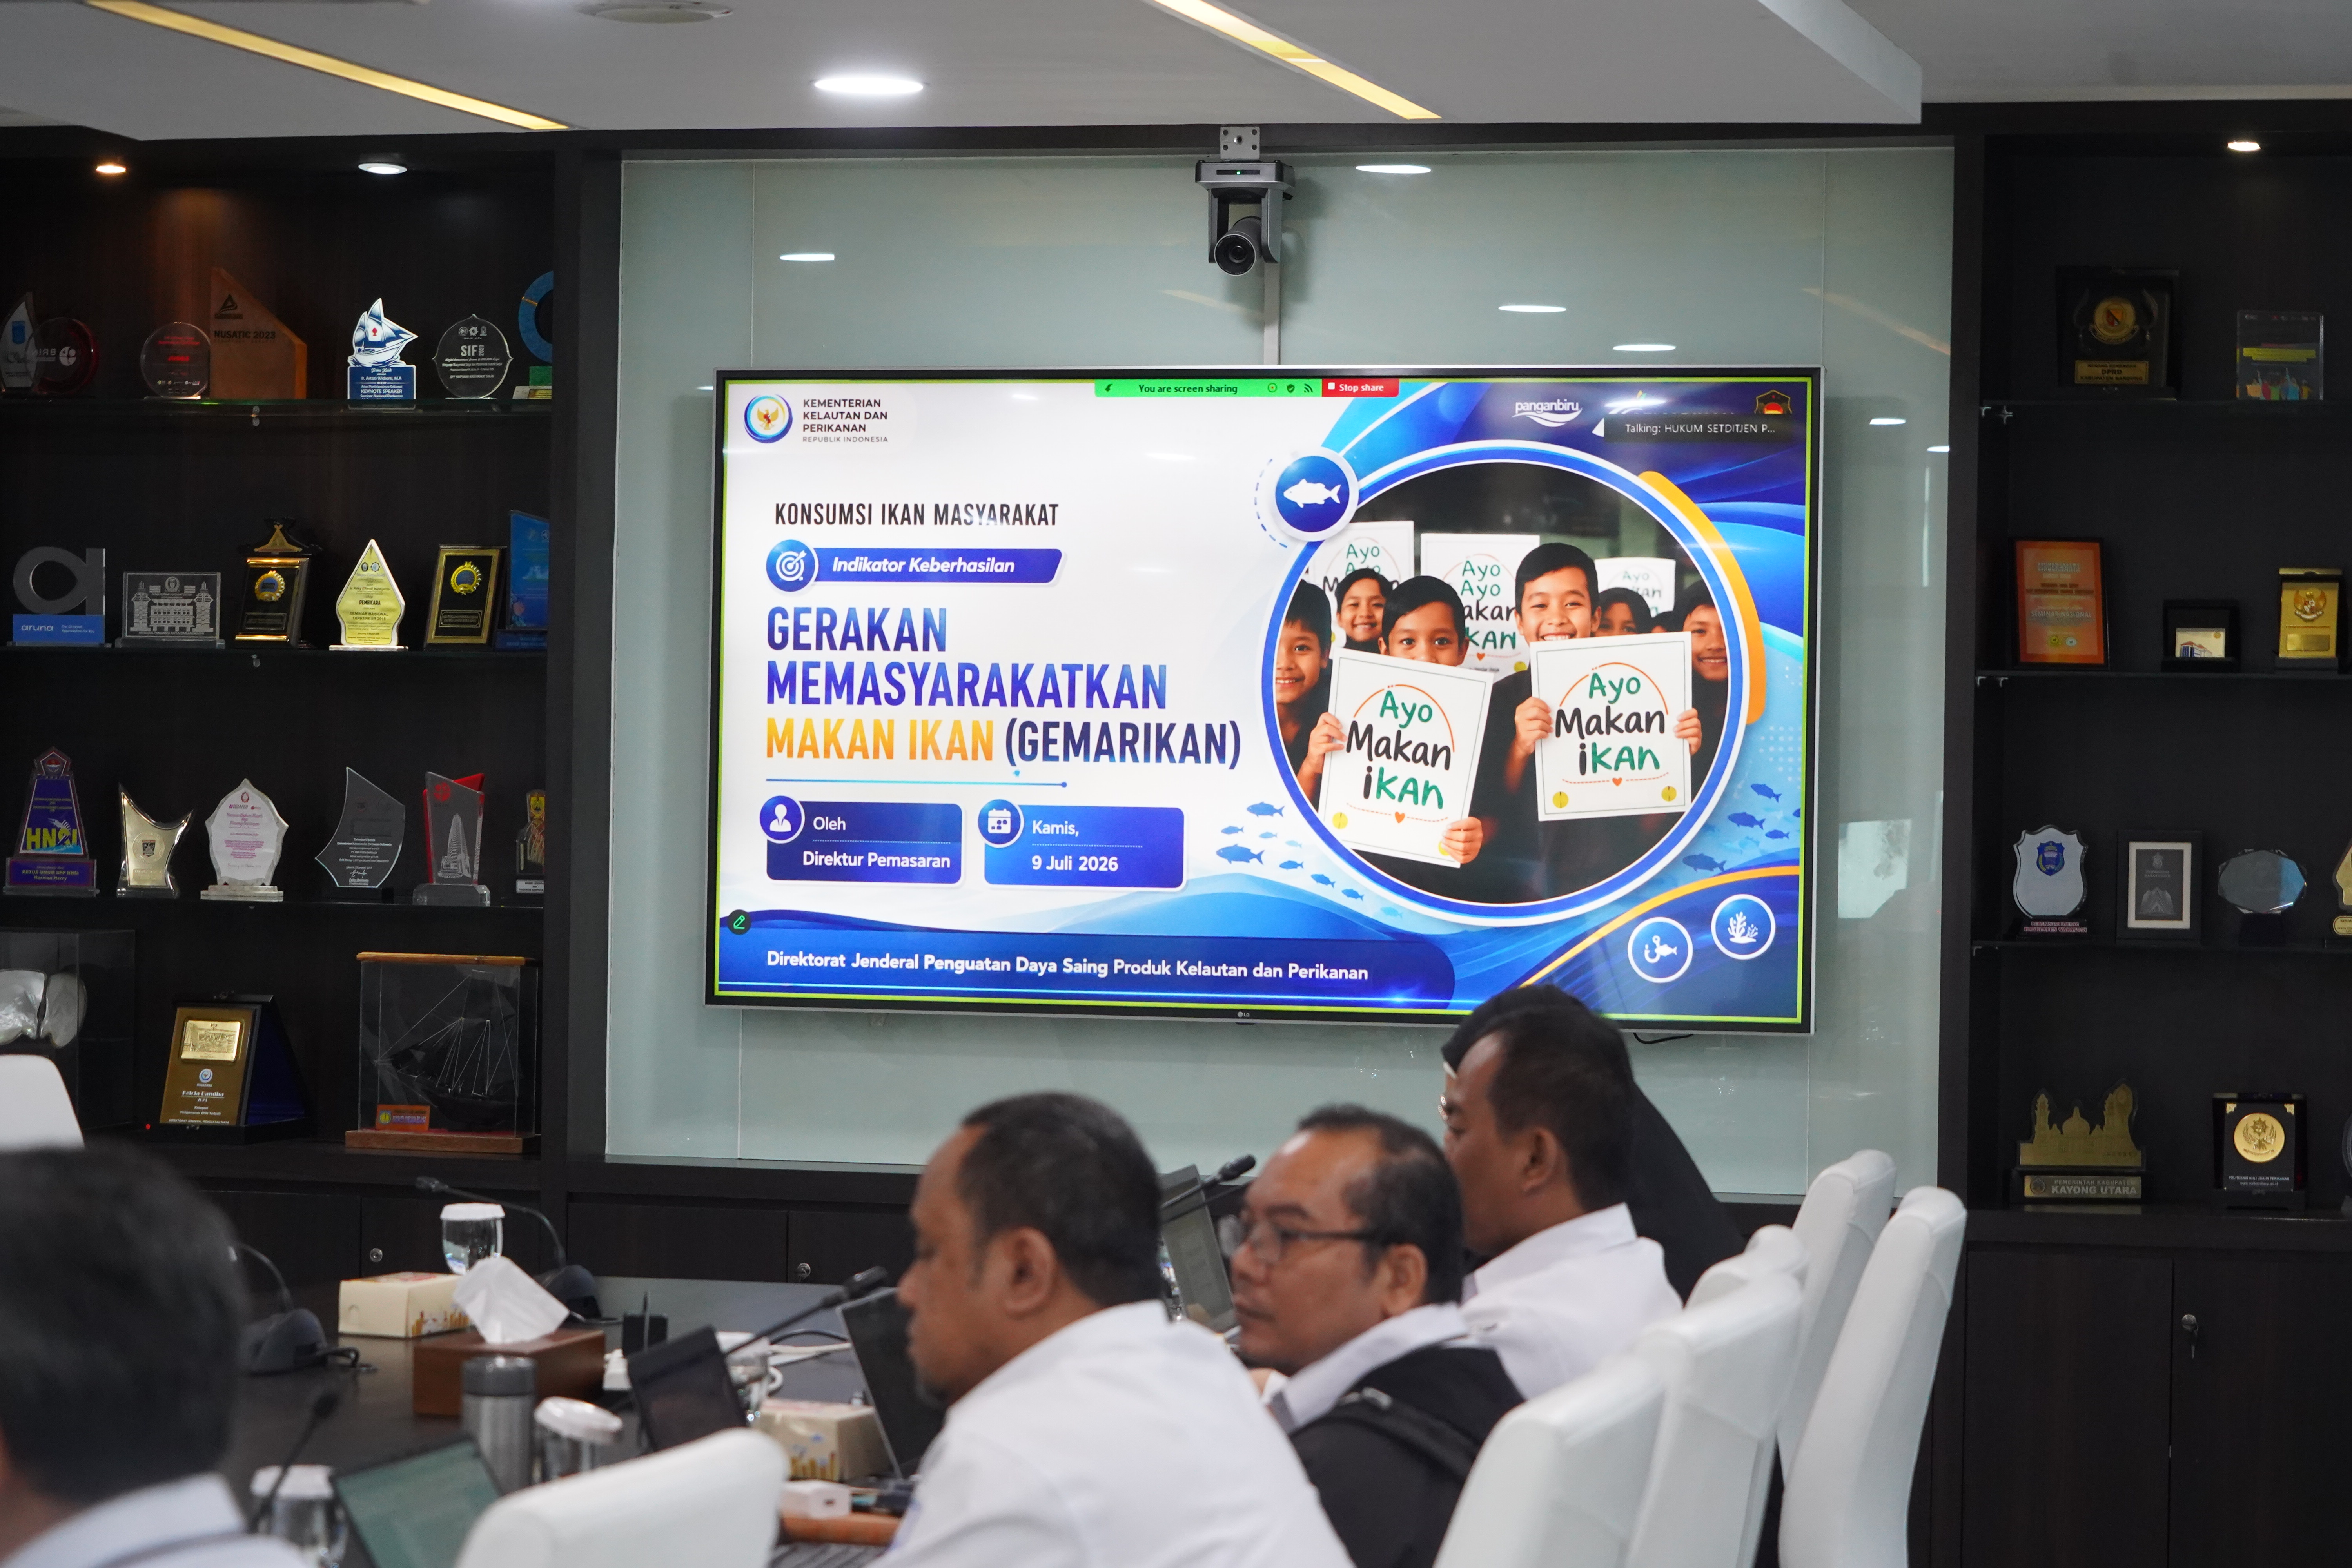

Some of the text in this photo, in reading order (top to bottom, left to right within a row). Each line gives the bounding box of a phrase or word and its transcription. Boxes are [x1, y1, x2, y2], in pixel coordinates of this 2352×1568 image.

[214, 330, 276, 339] NUSATIC 2023
[461, 345, 478, 356] SIF
[1139, 383, 1154, 393] You
[1206, 384, 1238, 394] sharing
[1339, 383, 1384, 394] Stop share
[803, 399, 881, 408] KEMENTERIAN
[1515, 399, 1579, 414] panganbiru
[803, 412, 887, 420] KELAUTAN DAN
[803, 424, 866, 432] PERIKANAN
[1626, 423, 1661, 435] Talking:
[1665, 424, 1703, 433] HUKUM
[775, 503, 1059, 526] KONSUMSI IKAN MASYARAKAT
[1346, 544, 1380, 564] Ayo
[832, 557, 1015, 573] Indikator Keberhasilan
[1345, 562, 1381, 575] Ao
[1463, 560, 1501, 582] Ayo
[1622, 570, 1649, 582] Ayo
[1461, 580, 1501, 601] Ayo
[767, 606, 947, 652] GERAKAN
[766, 660, 1167, 710] MEMASYARAKATKAN
[1588, 672, 1641, 704] Ayo
[1379, 690, 1433, 729] Ayo
[1555, 705, 1665, 740] Makan
[766, 717, 1241, 769] MAKAN IKAN (GEMARIKAN)
[1346, 720, 1451, 771] Makan
[813, 816, 847, 831] Oleh
[1032, 820, 1080, 837] Kamis,
[26, 828, 78, 850] HNSI
[802, 851, 951, 869] Direktur Pemasaran
[1032, 855, 1119, 872] 9 Juli 2026
[767, 951, 1368, 980] Direktorat Jenderal Penguatan Daya Saing Produk Kelautan dan Perikanan
[2051, 1186, 2137, 1194] KAYONG UTARA
